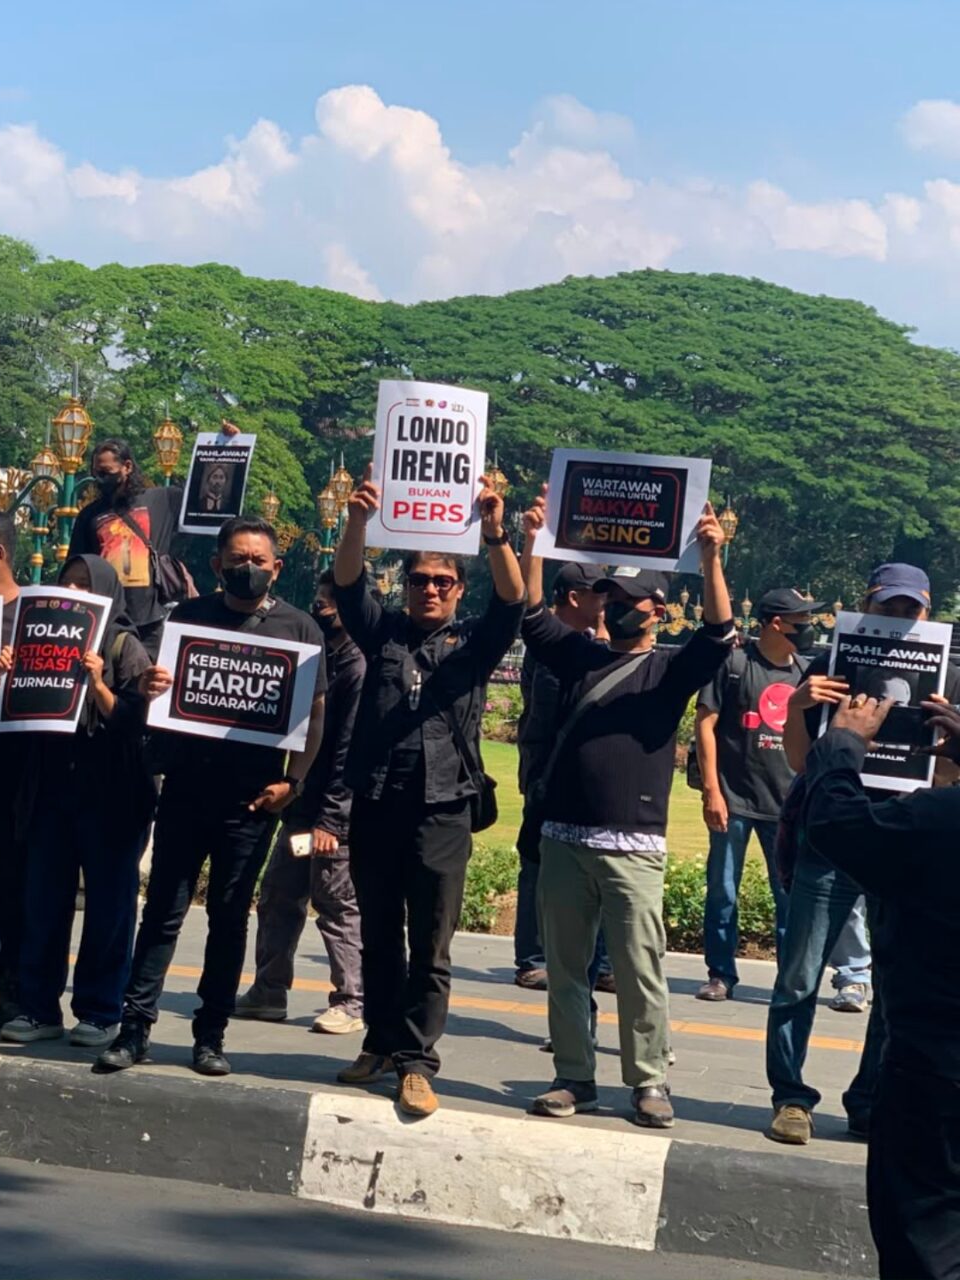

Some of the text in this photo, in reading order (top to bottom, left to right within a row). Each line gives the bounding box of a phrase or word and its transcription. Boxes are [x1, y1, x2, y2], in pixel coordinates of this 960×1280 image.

[397, 415, 469, 446] LONDO
[391, 449, 471, 485] IRENG
[408, 487, 451, 497] BUKAN
[582, 478, 662, 494] WARTAWAN
[584, 488, 657, 501] BERTANYA UNTUK
[393, 501, 464, 522] PERS
[580, 496, 659, 519] RAKYAT
[581, 522, 651, 545] ASING
[26, 623, 84, 640] TOLAK
[19, 643, 80, 659] STIGMA
[840, 642, 941, 664] PAHLAWAN
[22, 657, 72, 672] TISASI
[189, 653, 284, 678] KEBENARAN
[846, 655, 937, 672] YANG JURNALIS
[12, 677, 74, 689] JURNALIS
[186, 668, 281, 701] HARUS
[184, 691, 278, 715] DISUARAKAN
